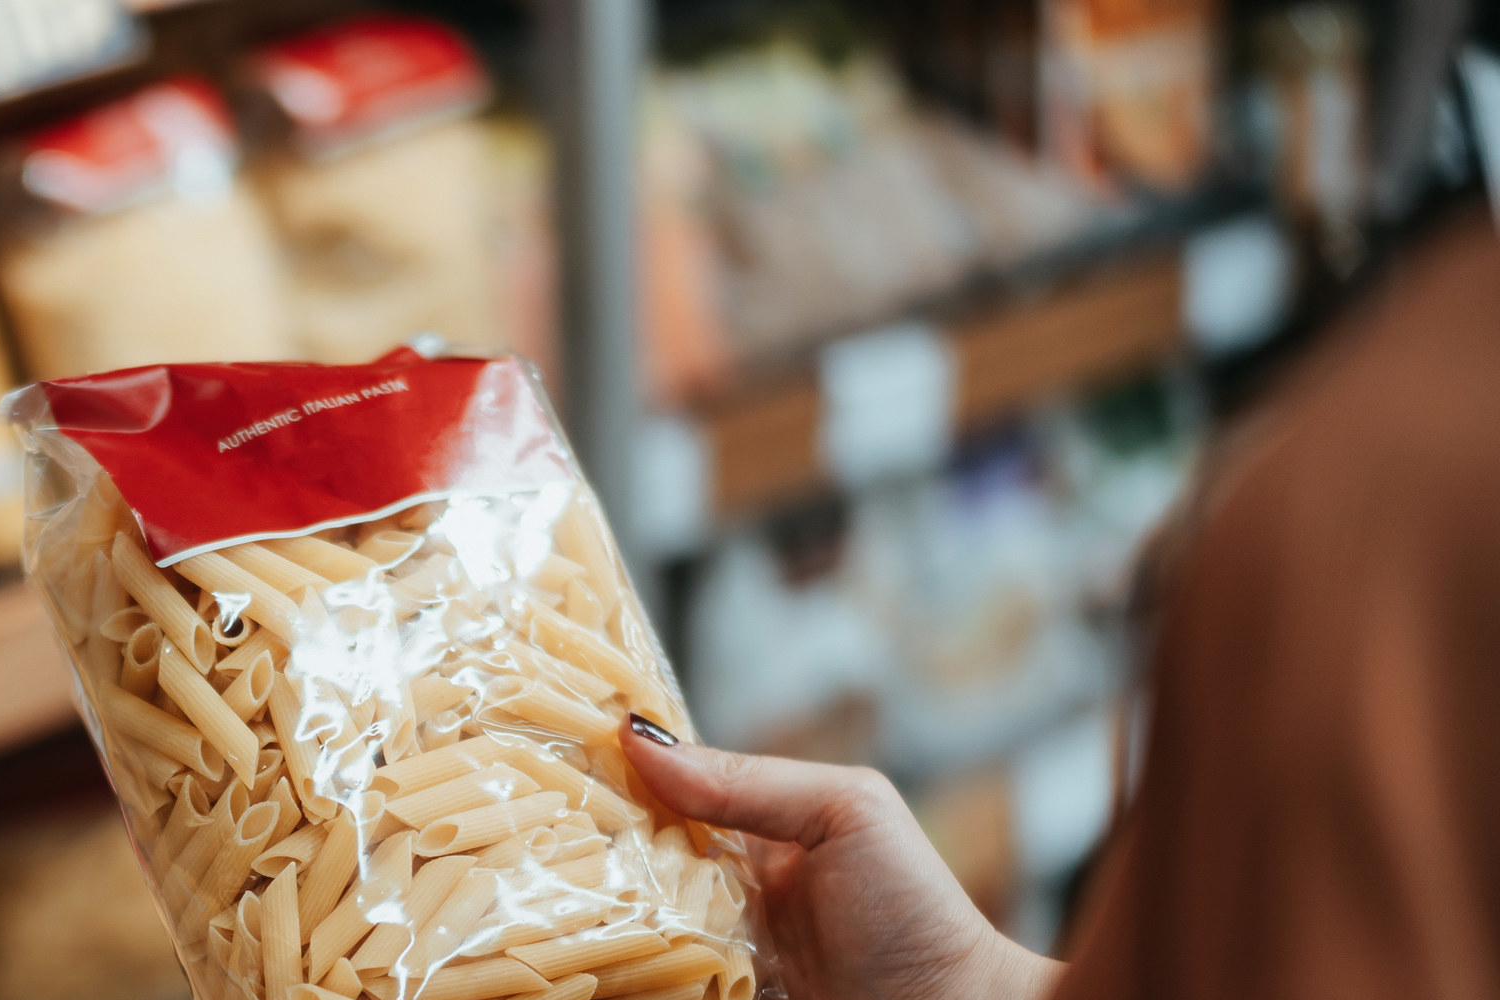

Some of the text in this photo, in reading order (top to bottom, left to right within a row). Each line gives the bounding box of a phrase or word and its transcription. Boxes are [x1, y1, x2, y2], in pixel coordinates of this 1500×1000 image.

[217, 379, 408, 453] AUTHENTIC ITALIAN PASTA
